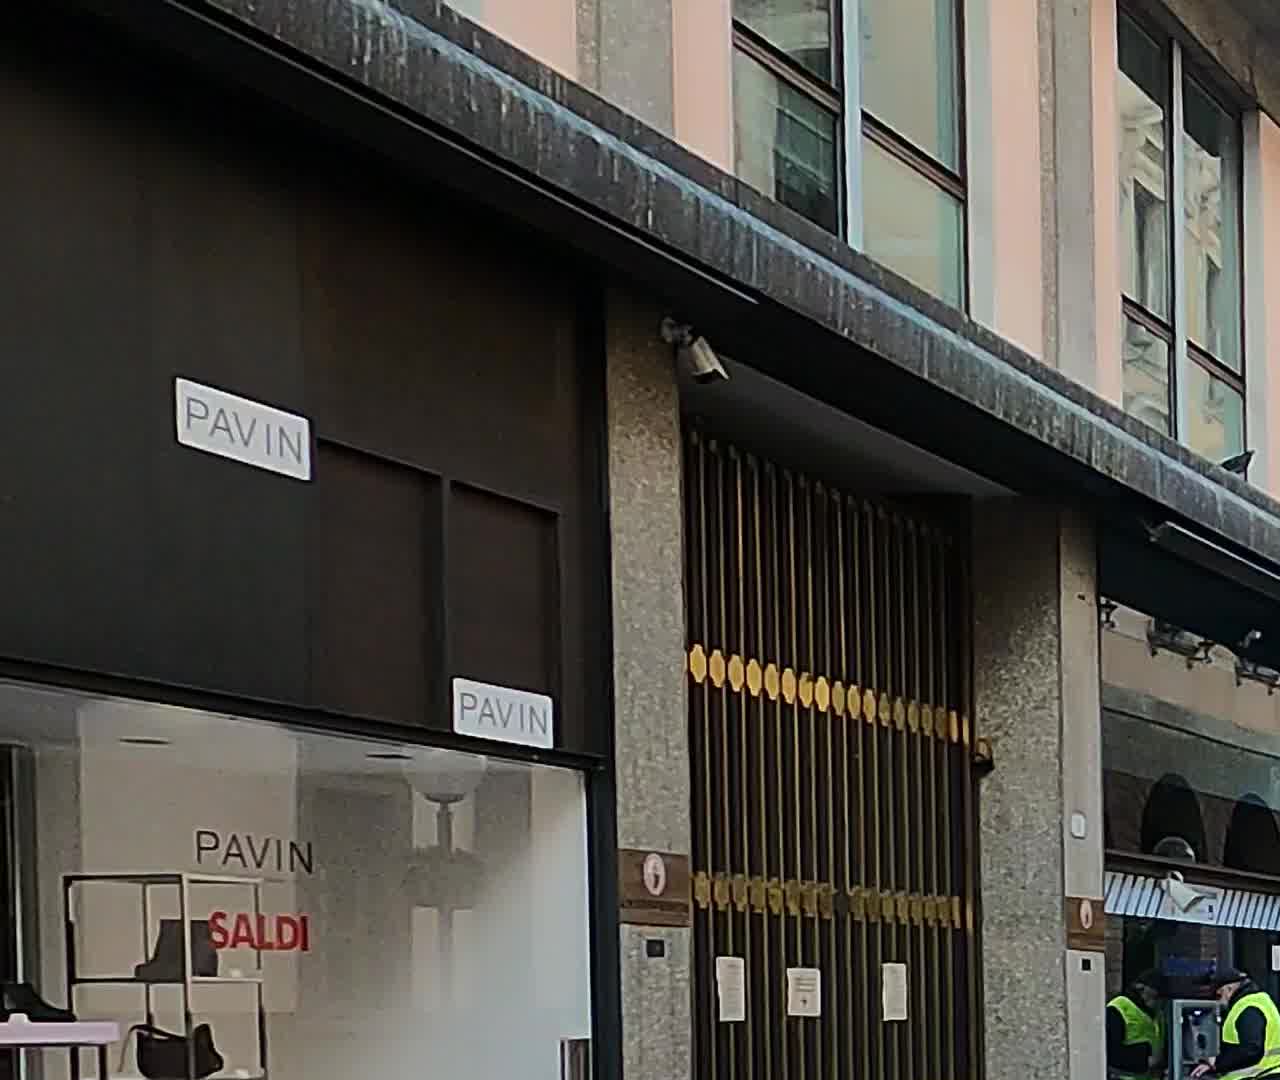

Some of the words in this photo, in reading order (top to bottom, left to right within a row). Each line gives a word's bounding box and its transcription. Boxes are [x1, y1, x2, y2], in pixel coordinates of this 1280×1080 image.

[186, 397, 304, 464] PAVIN
[460, 692, 547, 735] PAVIN
[196, 830, 312, 874] PAVIN
[208, 911, 309, 951] SALDI
